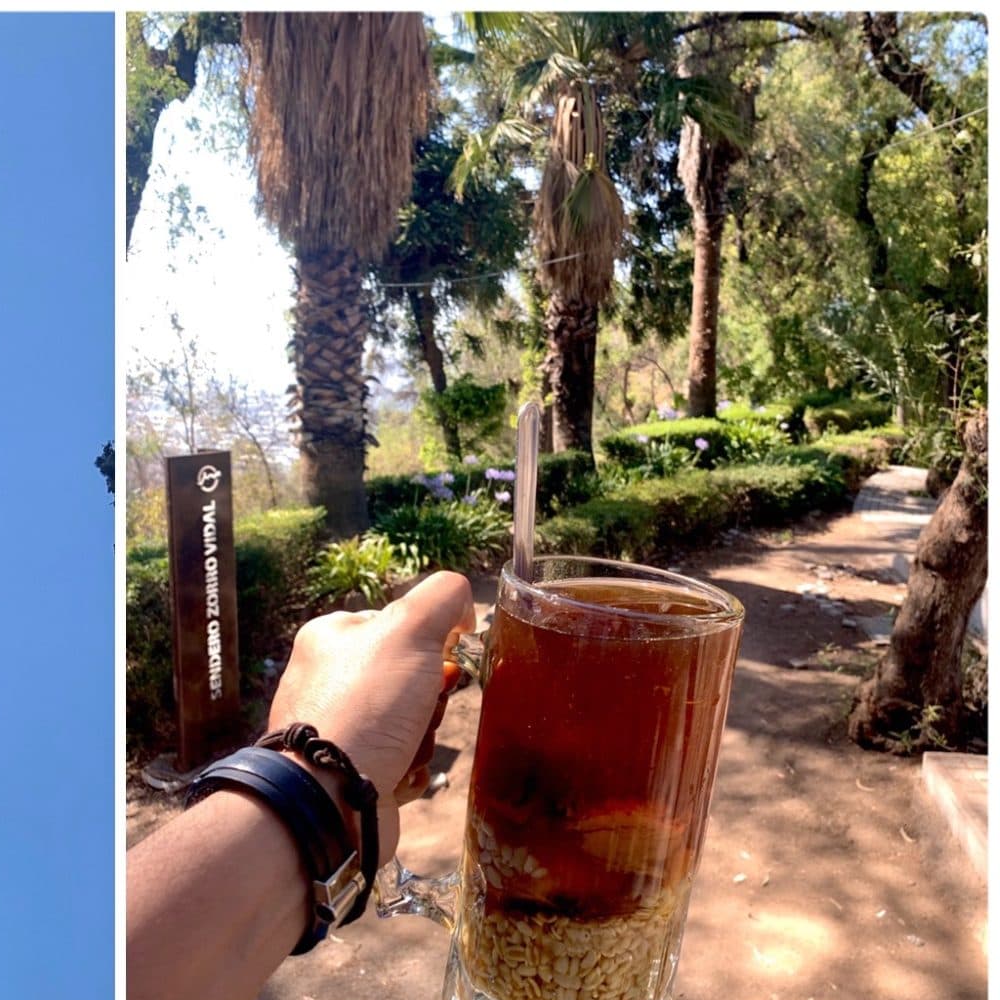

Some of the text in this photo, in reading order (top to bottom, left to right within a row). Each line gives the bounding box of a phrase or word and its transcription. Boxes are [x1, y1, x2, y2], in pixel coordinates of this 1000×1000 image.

[202, 501, 222, 700] SENDERO ZORRO VIDAL
